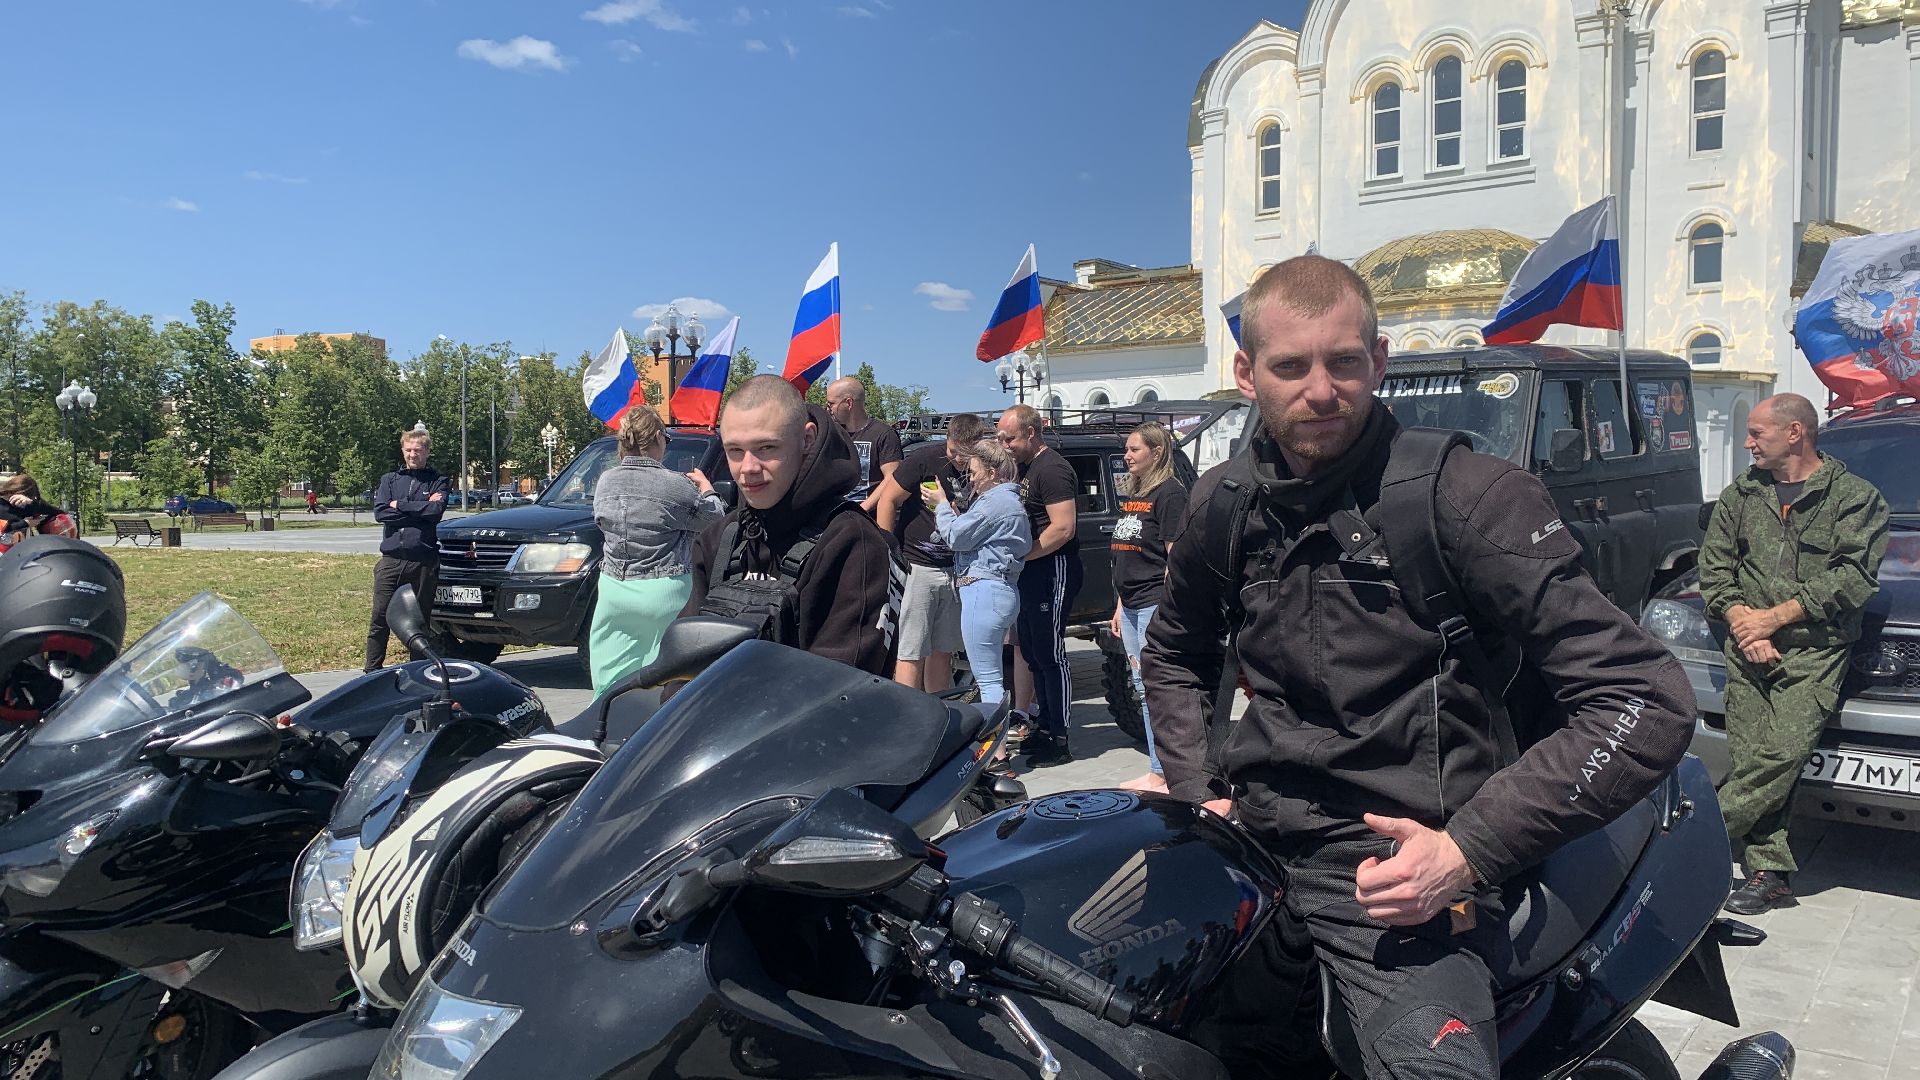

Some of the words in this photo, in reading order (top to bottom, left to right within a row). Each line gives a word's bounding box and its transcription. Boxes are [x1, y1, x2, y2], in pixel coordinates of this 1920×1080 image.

[1372, 375, 1465, 398] ГЕЛИК
[60, 579, 107, 592] LS2
[1800, 752, 1904, 787] 977МУ
[450, 935, 477, 967] ONDA
[1079, 918, 1186, 968] HONDA
